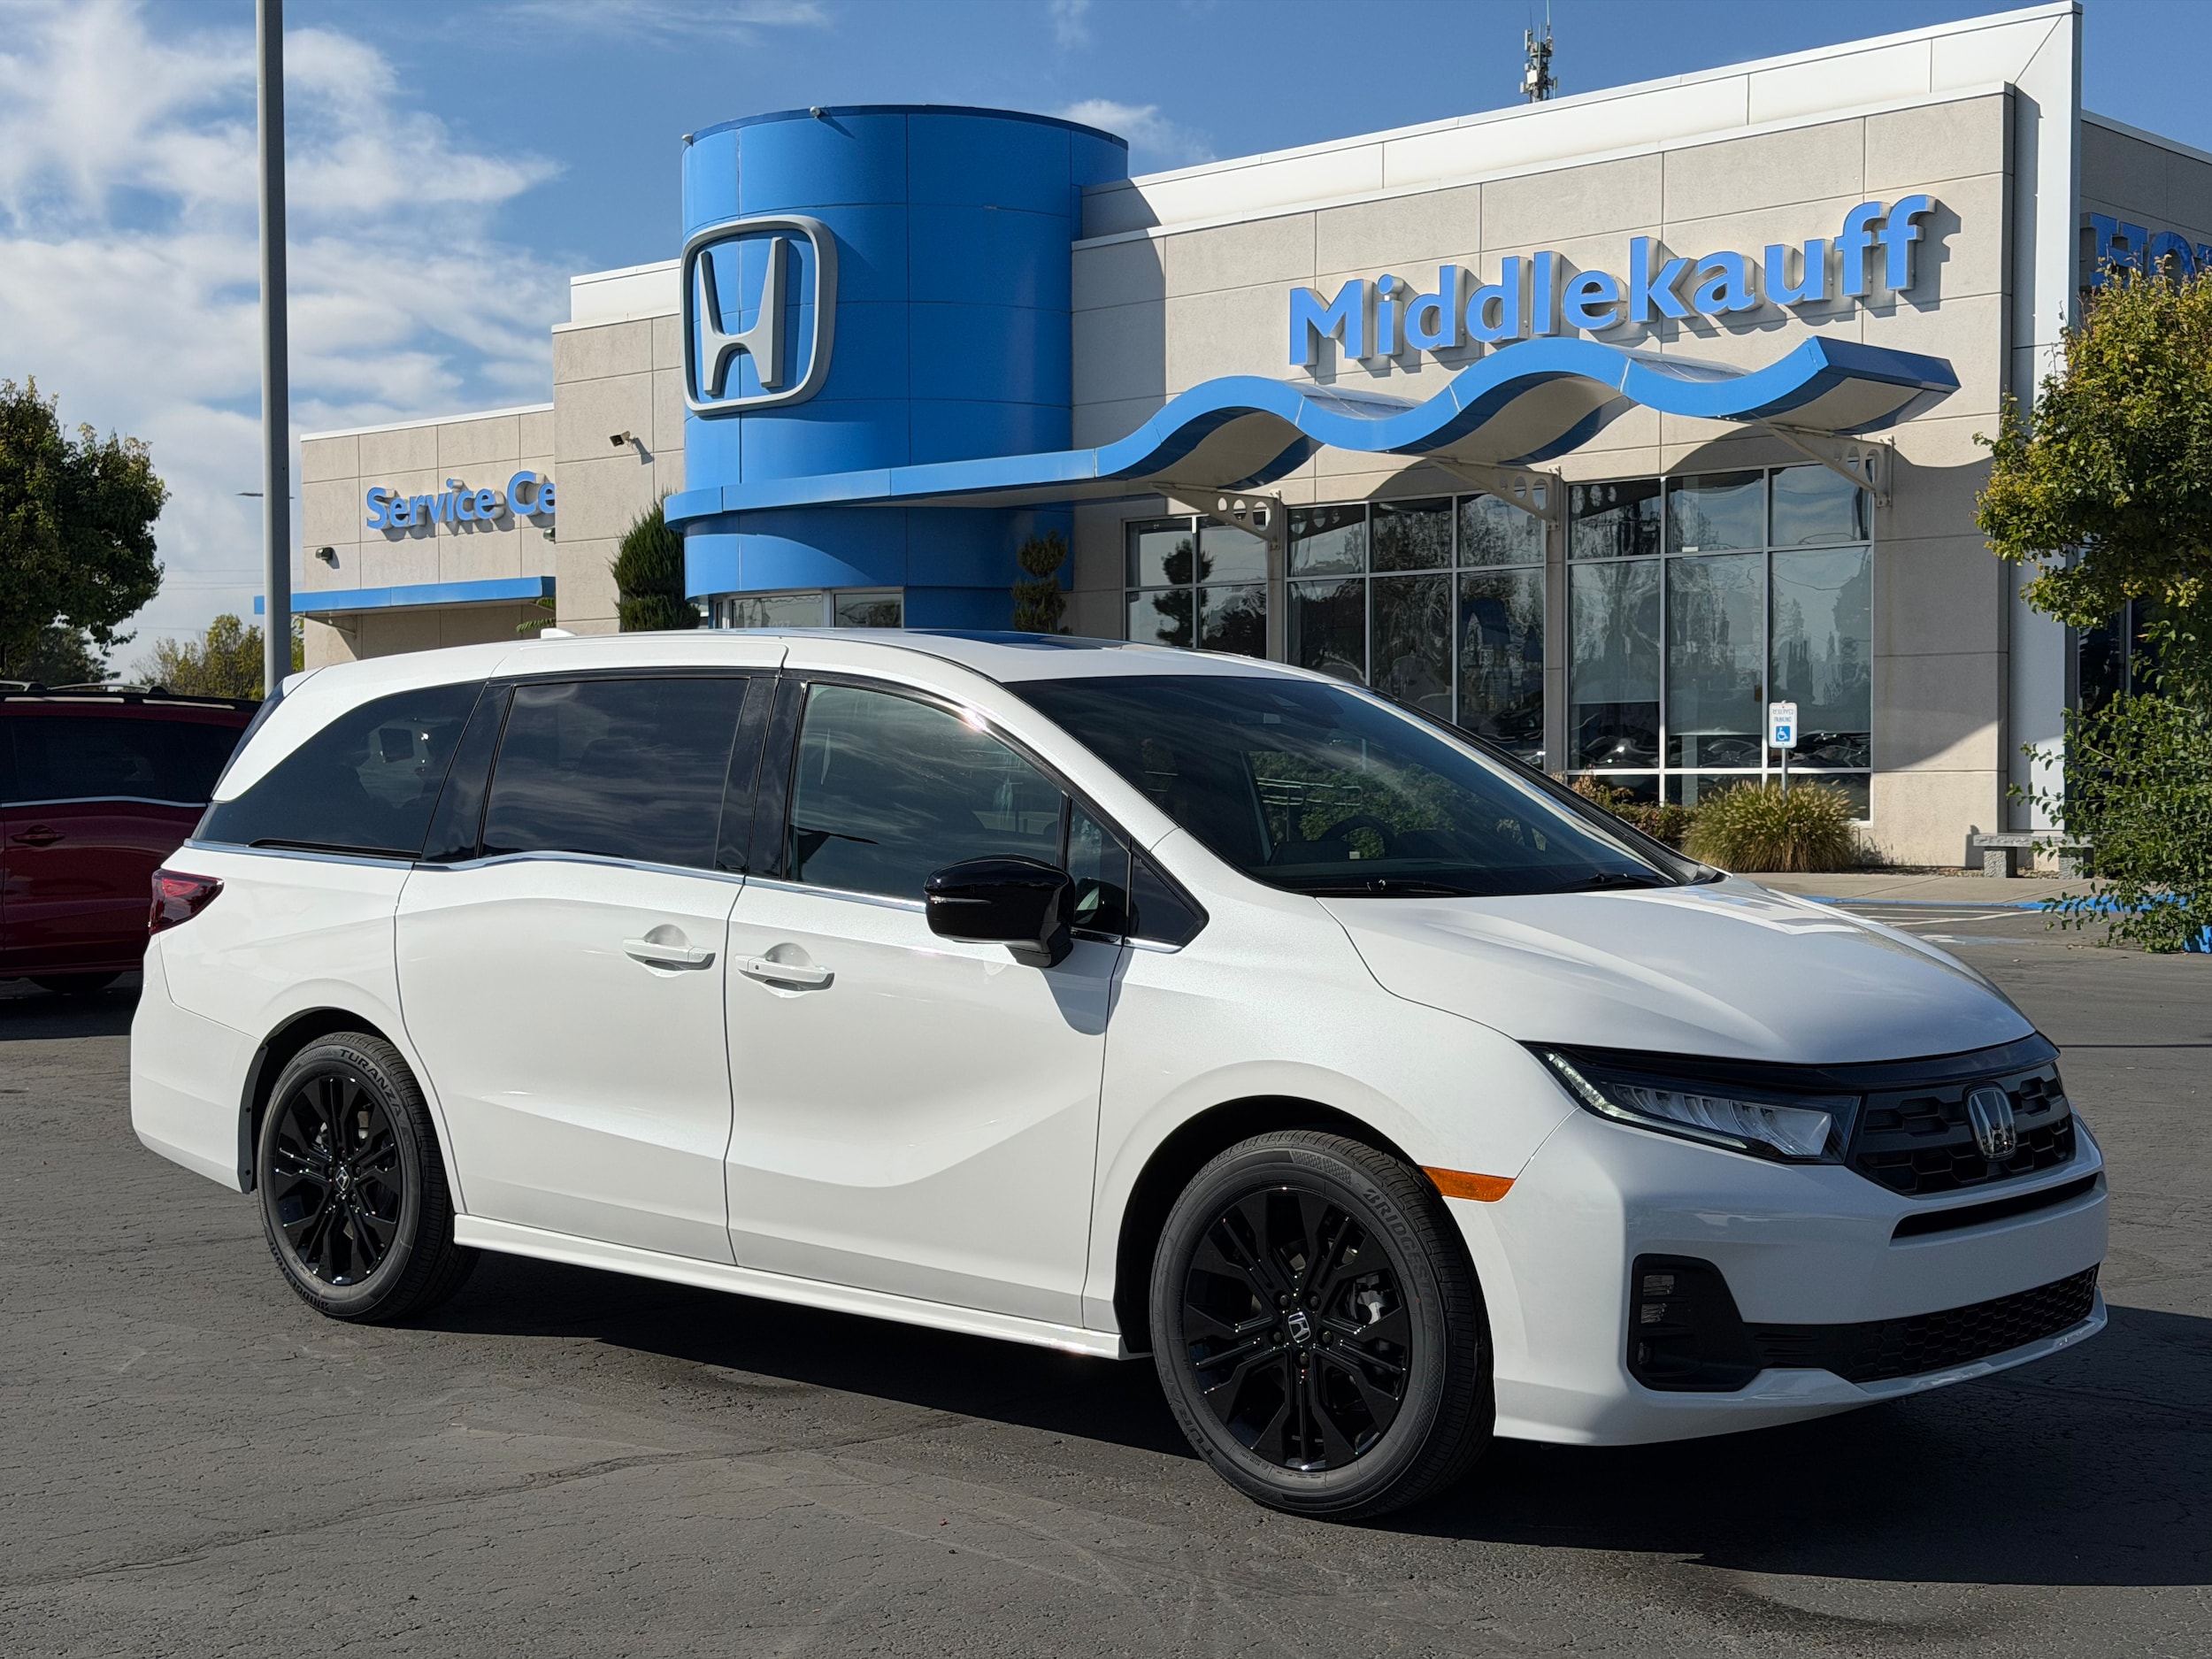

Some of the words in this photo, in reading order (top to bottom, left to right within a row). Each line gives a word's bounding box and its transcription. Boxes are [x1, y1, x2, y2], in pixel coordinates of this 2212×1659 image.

[1289, 194, 1938, 367] Middlekauff
[2089, 211, 2212, 292] HO
[366, 478, 498, 530] Service
[339, 1048, 403, 1118] TURANZA
